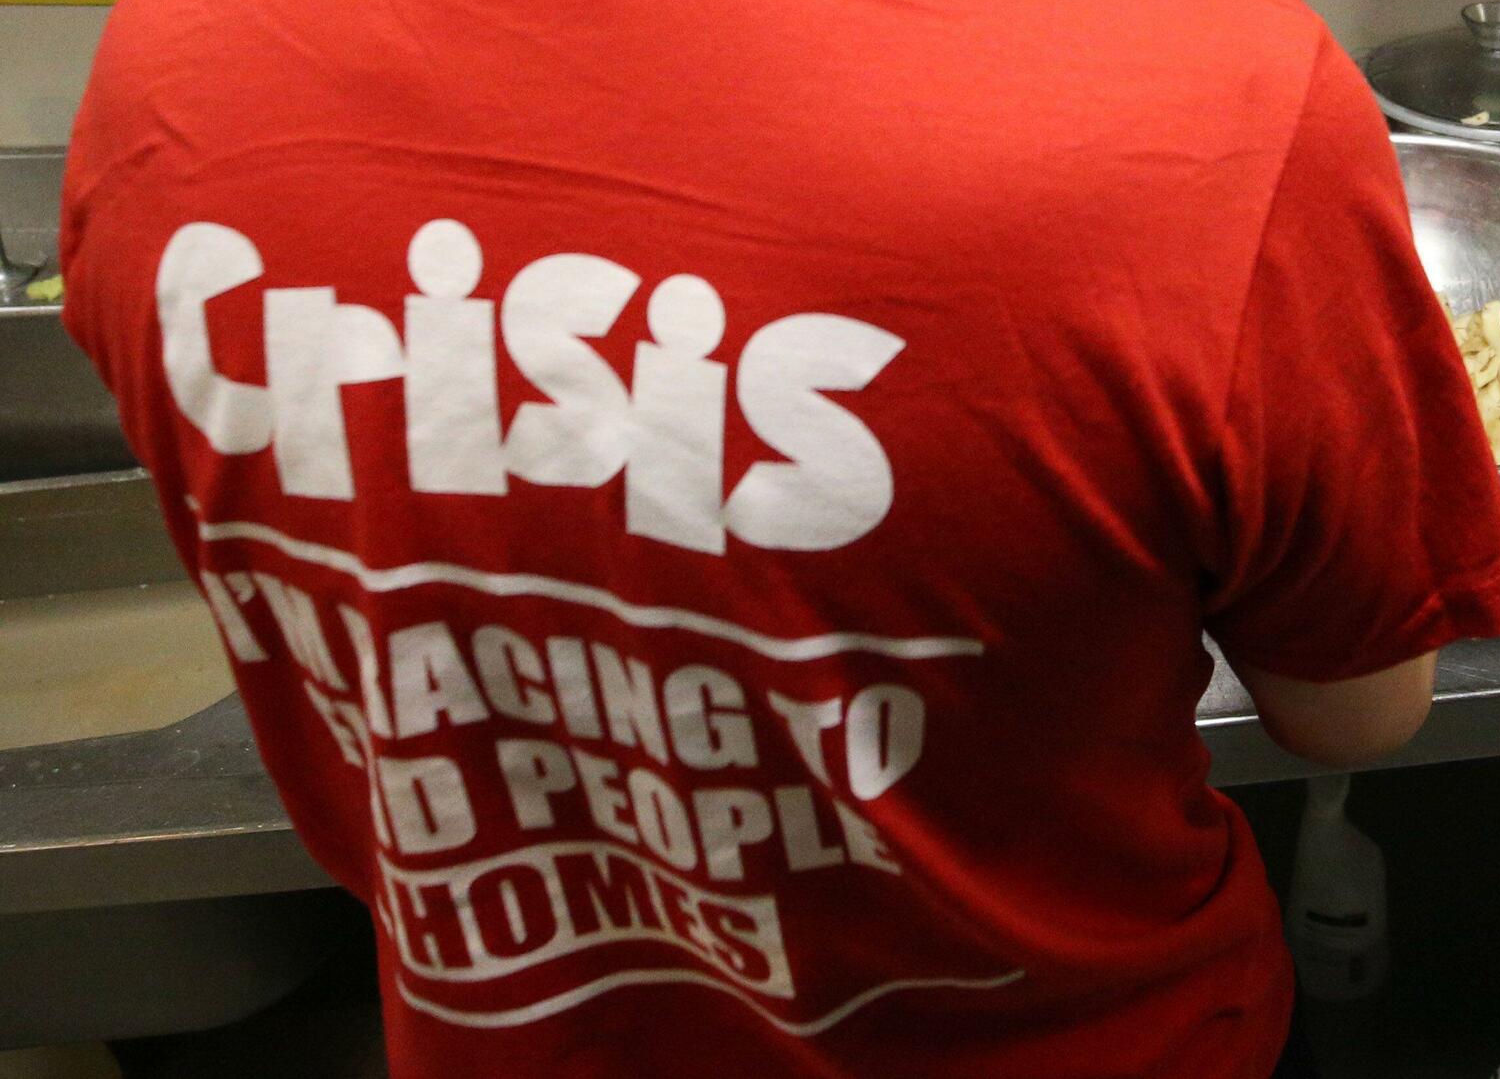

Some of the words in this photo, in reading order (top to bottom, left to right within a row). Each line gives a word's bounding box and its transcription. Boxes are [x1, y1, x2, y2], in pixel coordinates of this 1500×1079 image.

[156, 216, 907, 556] Crisis
[495, 738, 902, 883] PEOPLE
[767, 683, 925, 802] TO
[392, 847, 775, 983] HOMES
